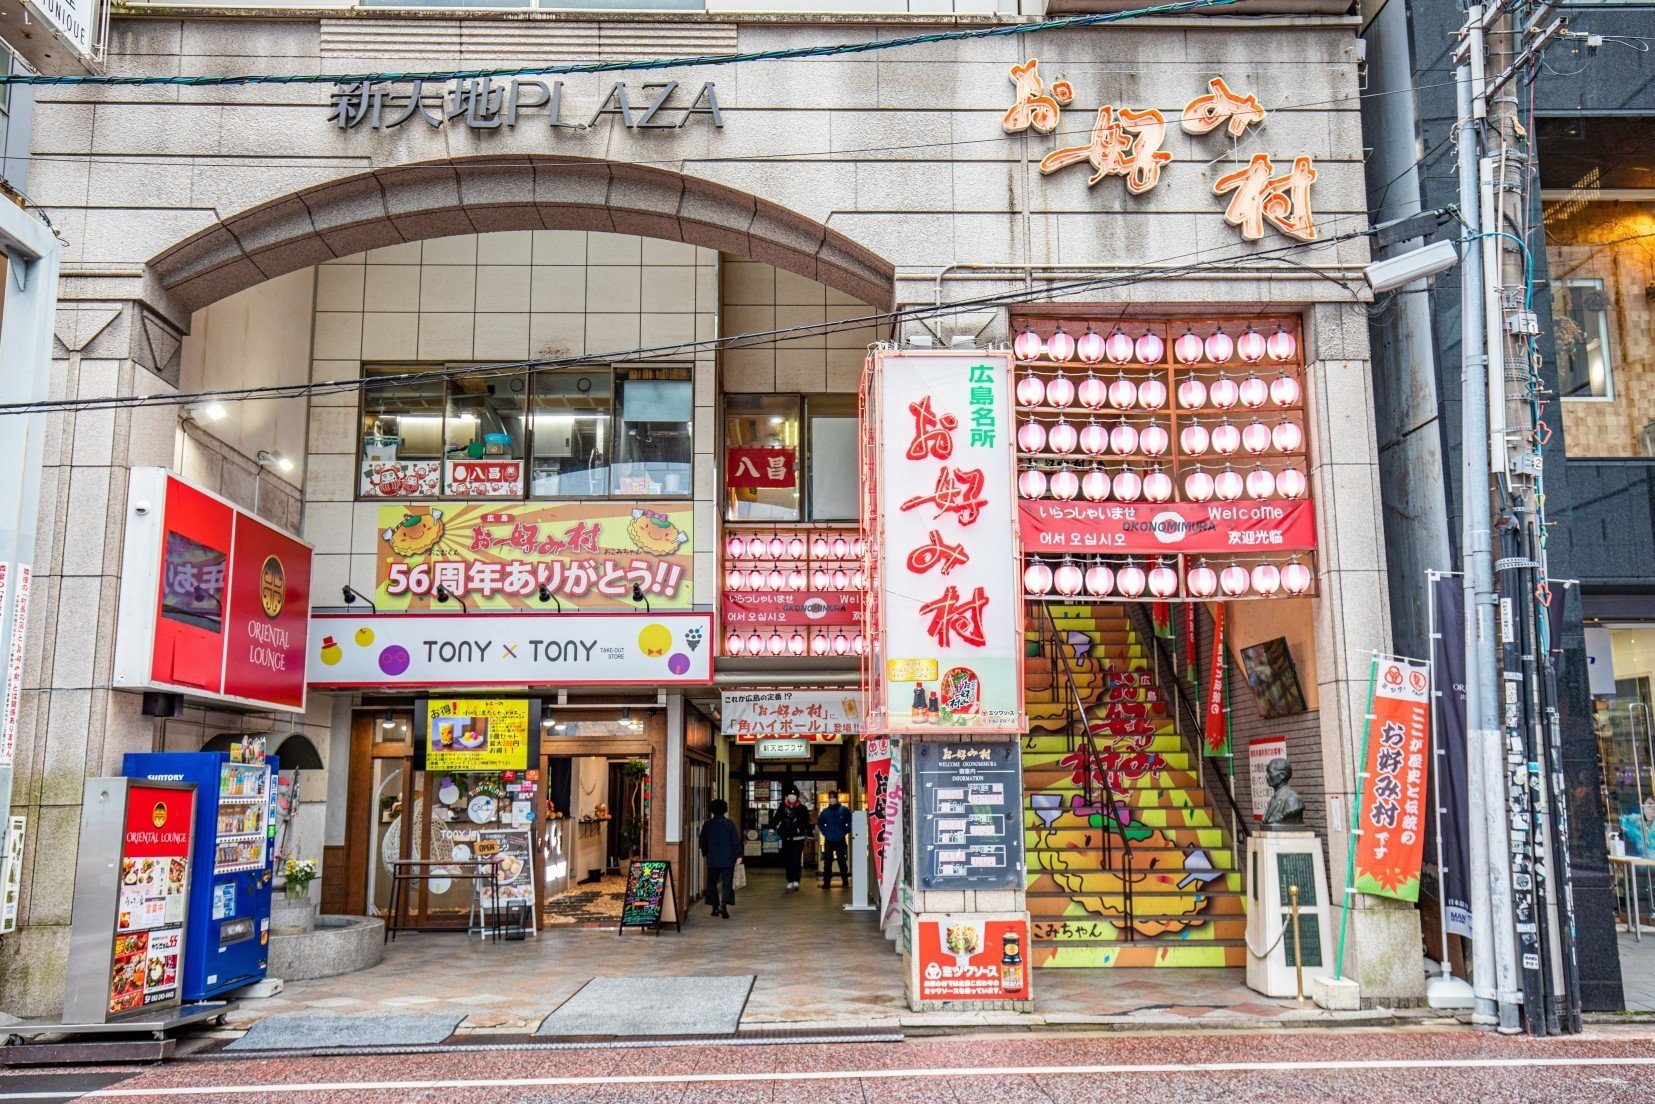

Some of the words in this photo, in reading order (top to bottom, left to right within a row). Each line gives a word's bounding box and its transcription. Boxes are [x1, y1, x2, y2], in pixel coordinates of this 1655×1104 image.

[1001, 58, 1317, 242] お好み村
[969, 364, 996, 448] 広島名所
[470, 466, 501, 479] 八昌
[734, 455, 787, 481] 八昌
[486, 514, 509, 522] 広島
[1039, 505, 1136, 521] いらっしゃいませ
[1208, 505, 1284, 520] Welcome
[900, 395, 990, 648] お好み村
[1122, 520, 1217, 533] OKONOMIMURA
[470, 521, 602, 555] お好み村
[1040, 532, 1066, 546] 어서
[1069, 531, 1127, 546] 오십시오
[1227, 530, 1283, 545] 欢迎光临
[603, 548, 643, 556] おこみちゃん
[387, 559, 683, 598] 56周年ありがとう!!
[782, 604, 846, 612] OKONOMIMURA
[727, 612, 746, 622] 어서
[748, 612, 787, 622] 오십시오
[248, 620, 290, 648] ORIENTAL
[423, 640, 492, 662] TONY
[529, 639, 597, 662] TONY
[250, 648, 286, 671] LOUNGE
[724, 692, 793, 703] これが広島の定番!?
[762, 744, 803, 752] 新天地プラザ
[942, 747, 991, 760] お好み村
[1400, 706, 1425, 846] ここが歴史と伝統の
[126, 831, 159, 844] ORIENTAL
[160, 832, 187, 843] LOUNGE
[479, 844, 495, 853] OPEN
[942, 965, 999, 977] ミツワソース
